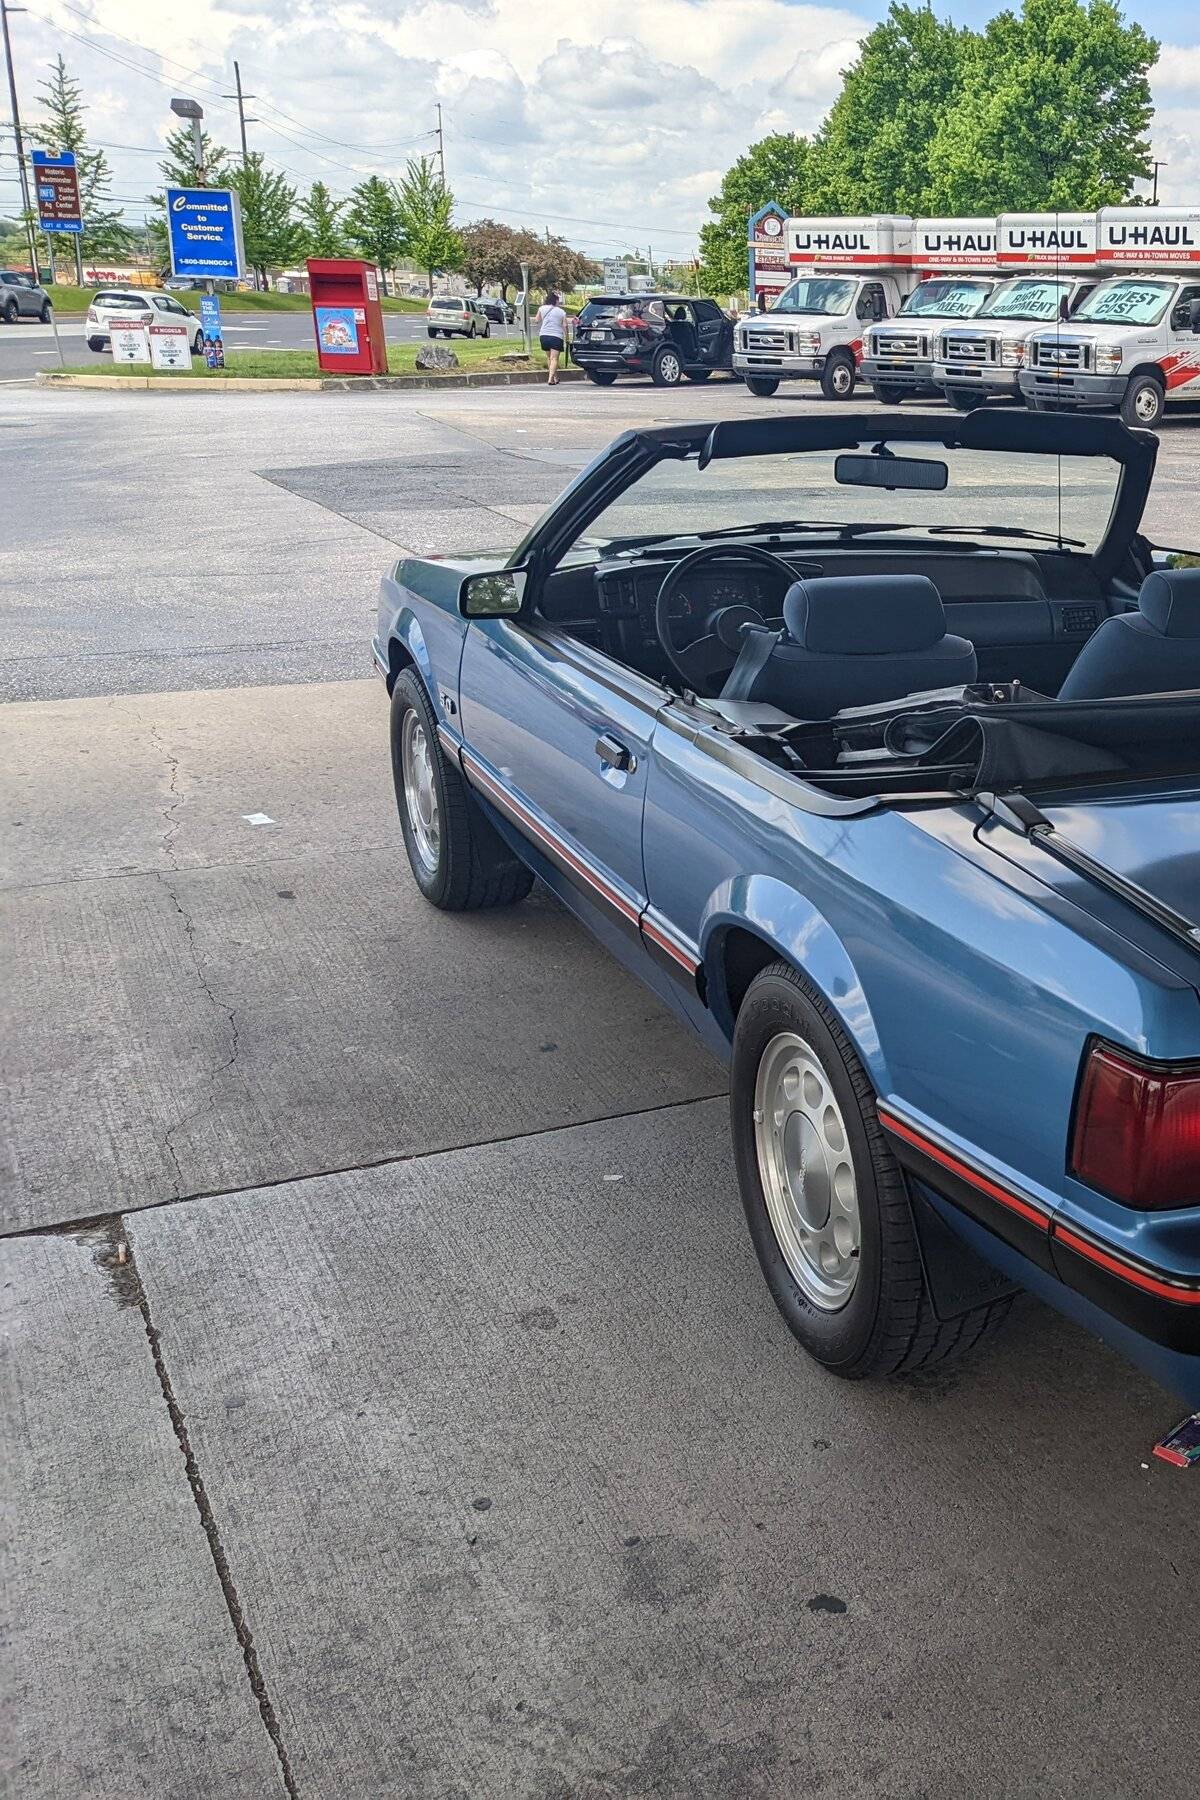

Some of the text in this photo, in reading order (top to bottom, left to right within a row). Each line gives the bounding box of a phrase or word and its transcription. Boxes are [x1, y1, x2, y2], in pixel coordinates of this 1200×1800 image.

[172, 196, 228, 212] Committed
[197, 214, 208, 222] to
[181, 223, 224, 232] Customer
[186, 232, 224, 241] Service.
[1009, 230, 1088, 248] U-HAUL
[1109, 226, 1194, 245] U-HAUL
[795, 234, 870, 250] U-HAUL
[179, 258, 233, 266] 1-800-SUNOCO-1
[757, 255, 785, 264] STAPLE
[1169, 252, 1191, 260] MOVES
[1013, 289, 1047, 303] RIGHT
[992, 301, 1057, 315] EQUIPMENT
[1096, 303, 1138, 315] COST
